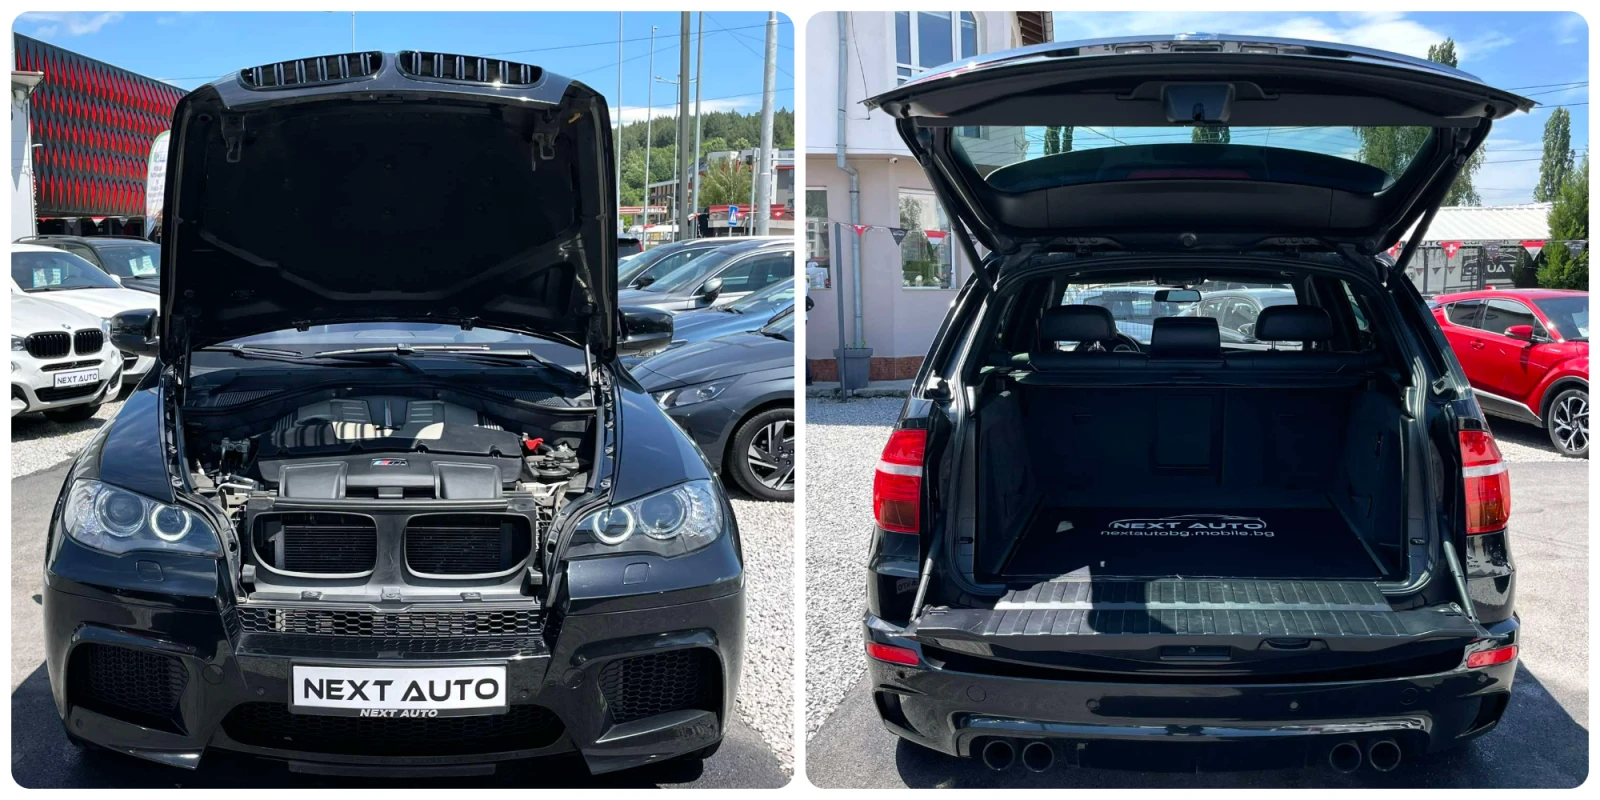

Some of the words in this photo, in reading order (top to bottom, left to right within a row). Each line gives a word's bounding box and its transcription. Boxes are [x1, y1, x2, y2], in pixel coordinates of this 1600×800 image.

[57, 375, 77, 385] NEXT
[78, 373, 97, 382] AUTO
[304, 678, 394, 701] NEXT
[400, 678, 499, 701] AUTO
[360, 709, 398, 717] NEXT
[400, 709, 438, 717] AUTO
